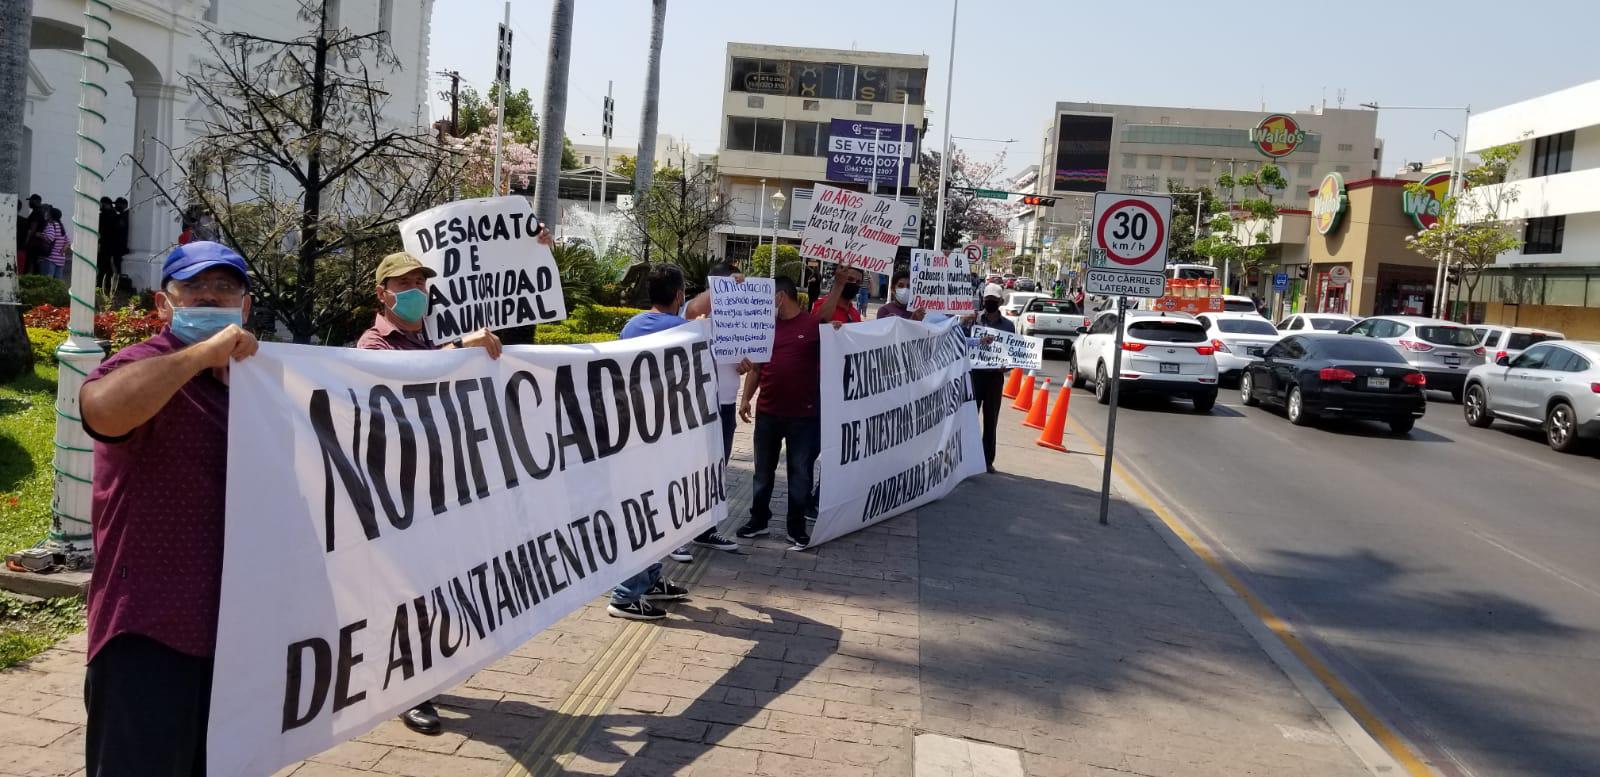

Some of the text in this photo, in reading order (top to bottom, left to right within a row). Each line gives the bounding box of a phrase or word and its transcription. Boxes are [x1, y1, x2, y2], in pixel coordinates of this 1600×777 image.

[835, 140, 852, 151] SE
[1252, 128, 1304, 145] Waldo's
[833, 154, 852, 163] 667
[855, 156, 873, 166] 766
[832, 189, 863, 209] AÑOS
[416, 213, 541, 254] DESACATO
[825, 237, 833, 246] A
[1112, 211, 1148, 241] 30
[443, 245, 481, 278] DE
[427, 266, 552, 316] AUTORIDAD
[1090, 273, 1161, 285] SOLO CARRILES
[1099, 284, 1150, 294] LATERALES
[436, 294, 557, 340] MUNICIPAL
[842, 343, 902, 401] EXIGIMOS
[310, 339, 719, 553] NOTIFICADORE
[840, 420, 861, 466] DE
[864, 402, 914, 459] NUESTROS
[862, 461, 925, 522] CONDENADA
[281, 619, 367, 733] DE
[382, 510, 617, 690] AYUNTAMIENTO
[620, 490, 665, 552] DE
